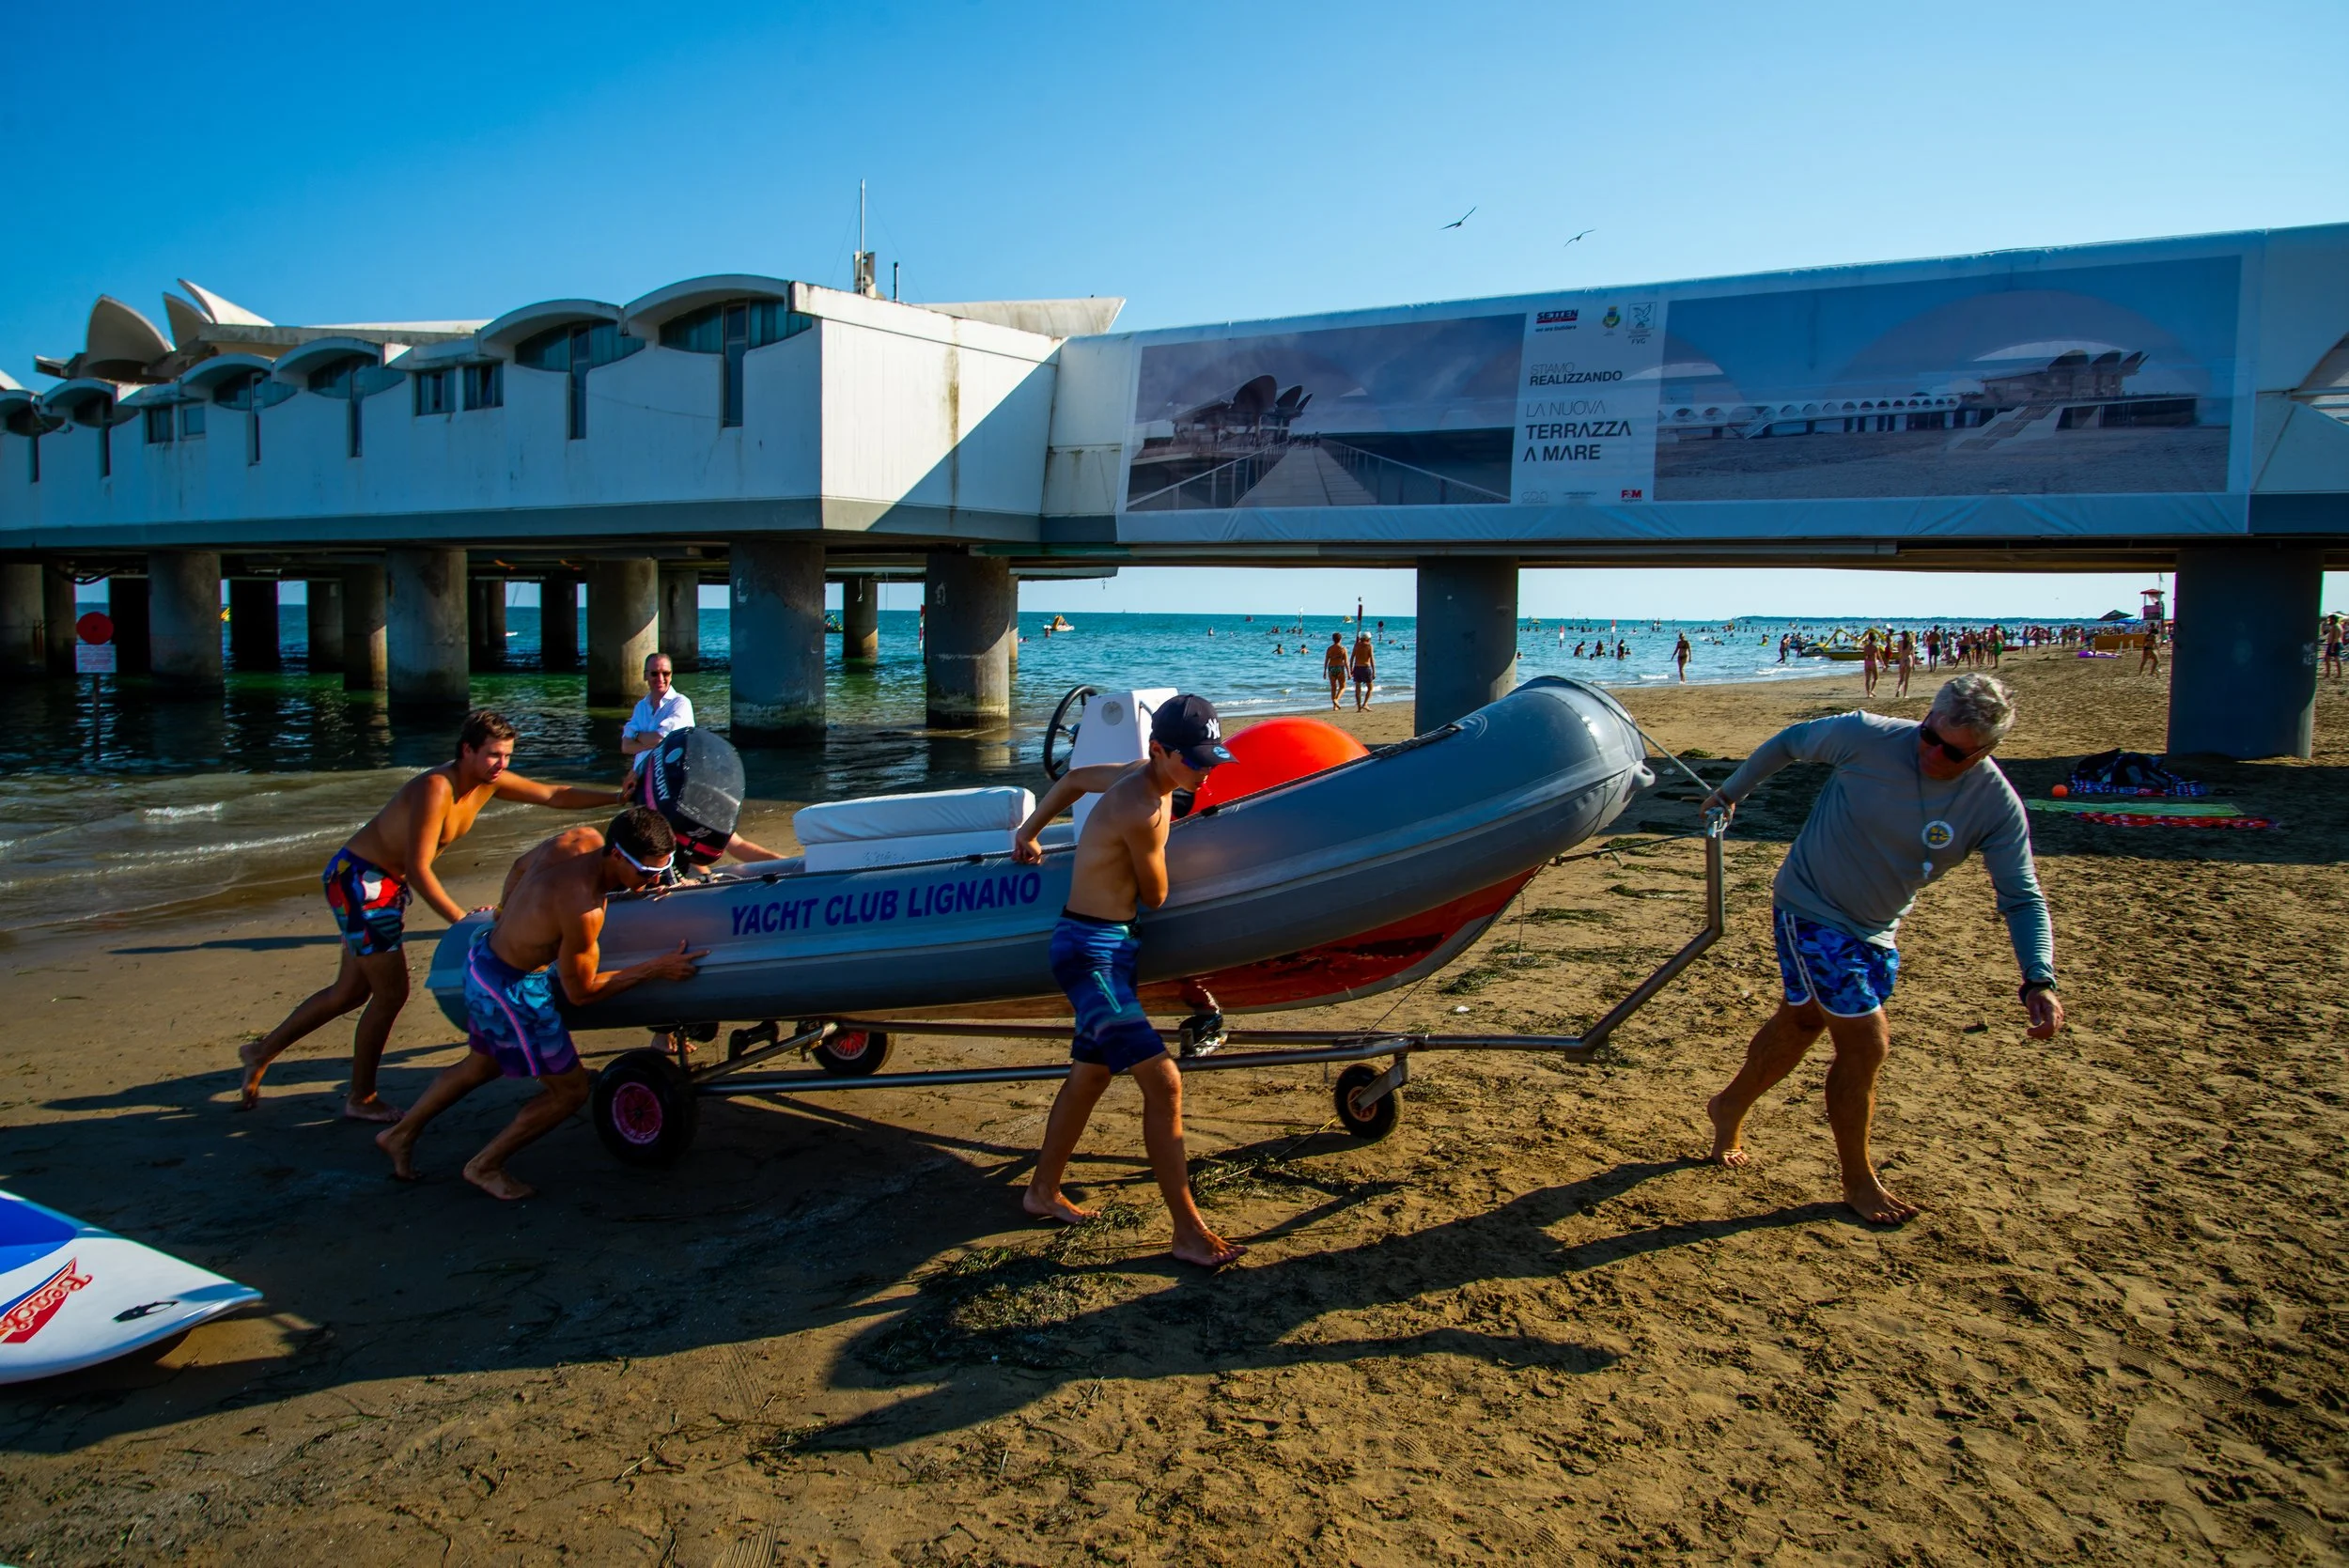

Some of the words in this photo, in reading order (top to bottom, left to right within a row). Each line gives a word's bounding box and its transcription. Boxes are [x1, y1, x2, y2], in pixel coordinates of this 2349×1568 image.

[1536, 309, 1579, 321] SETTEN
[1530, 362, 1575, 375] STIAMO
[1530, 370, 1623, 386] REALIZZANDO
[1526, 403, 1545, 418] LA
[1549, 400, 1606, 416] NUOVA
[1525, 421, 1632, 440] TERRAZZA
[1523, 446, 1536, 462] A
[1543, 444, 1601, 461] MARE
[1206, 718, 1221, 739] NY
[731, 897, 820, 937] YACHT
[824, 890, 899, 926] CLUB
[906, 872, 1042, 919] LIGNANO
